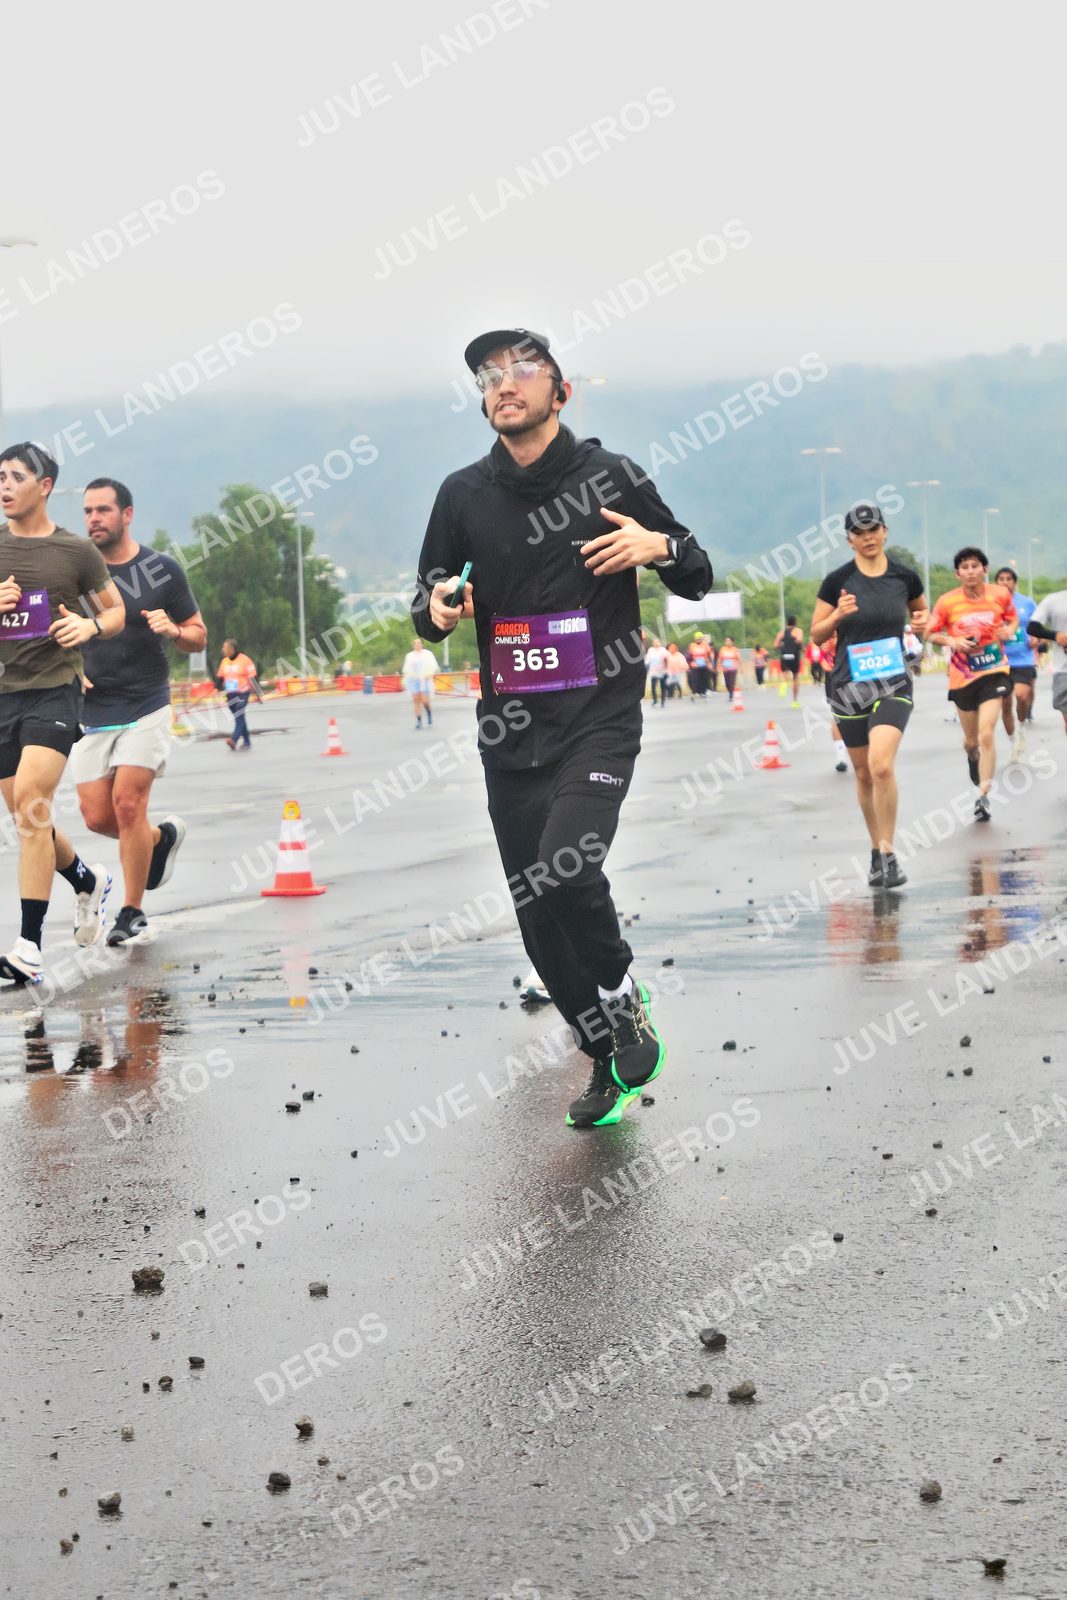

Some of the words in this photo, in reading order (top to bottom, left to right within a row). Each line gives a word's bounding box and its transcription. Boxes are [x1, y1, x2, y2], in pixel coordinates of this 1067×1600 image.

[2, 612, 30, 627] 427
[495, 623, 530, 635] CARRERA
[512, 647, 560, 672] 363
[858, 654, 892, 671] 2026
[590, 772, 624, 787] ECHT
